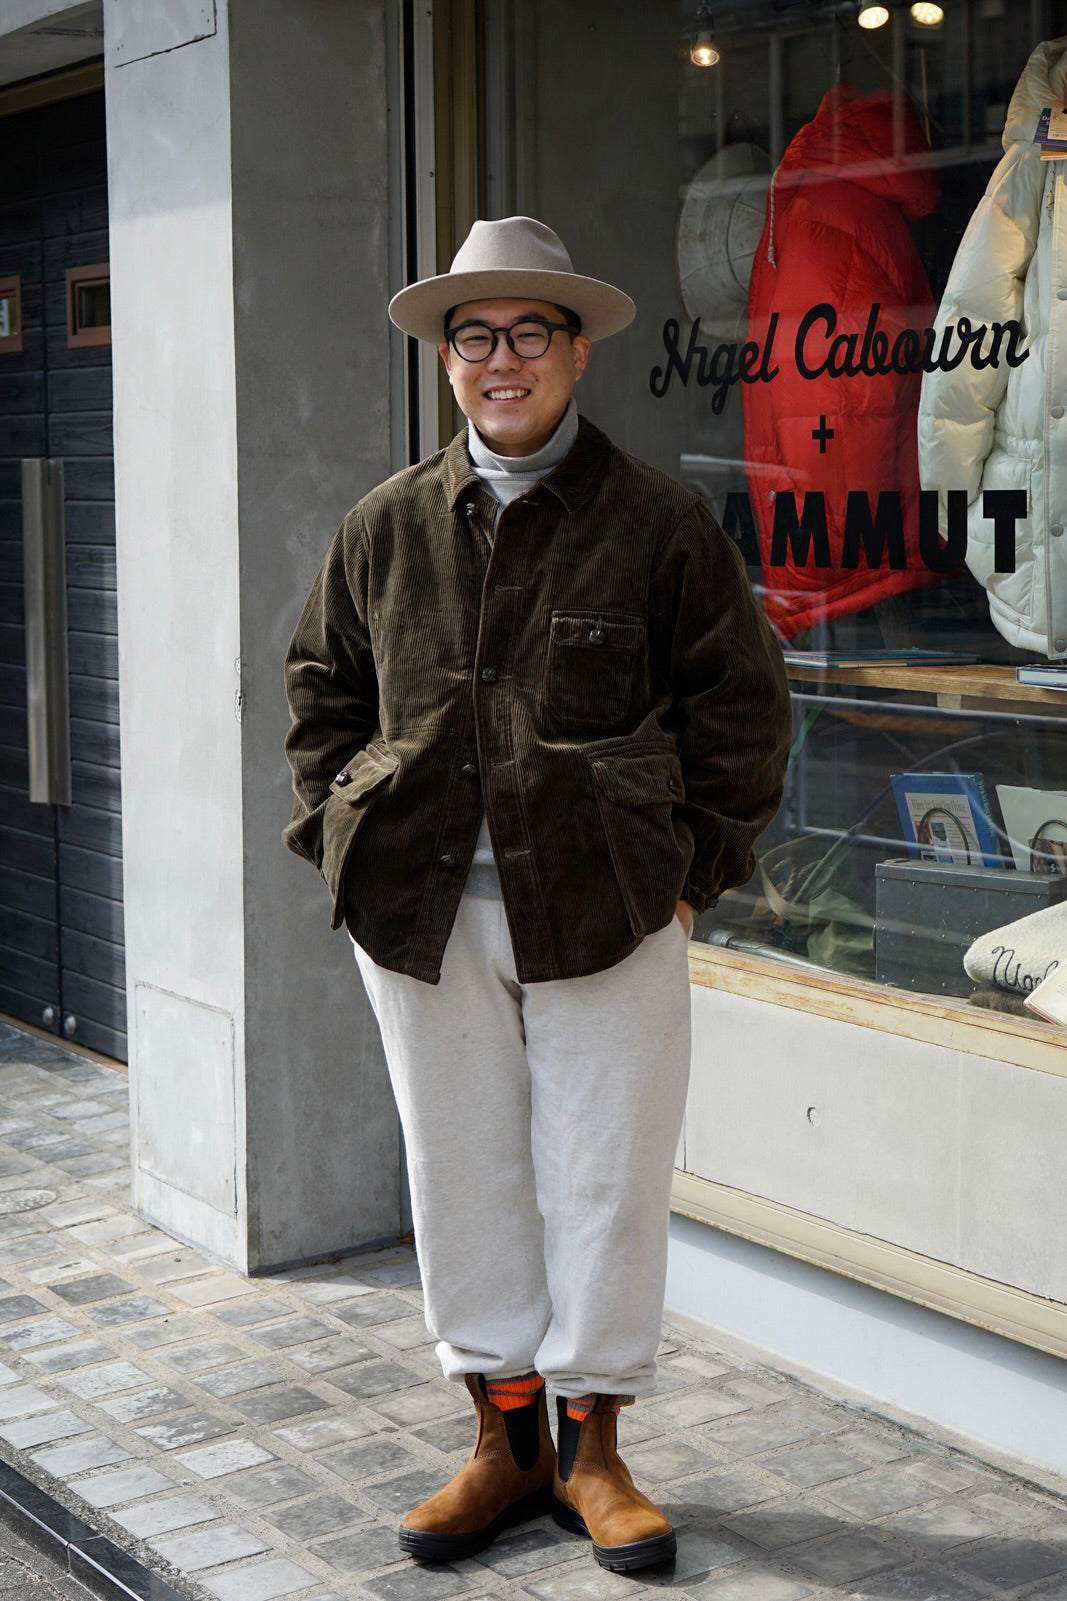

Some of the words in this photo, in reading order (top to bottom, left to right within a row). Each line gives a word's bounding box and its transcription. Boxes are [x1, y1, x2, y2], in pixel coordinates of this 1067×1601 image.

[649, 312, 780, 415] Nigel
[794, 302, 1030, 380] Cabourn
[720, 489, 1028, 574] AMMUT
